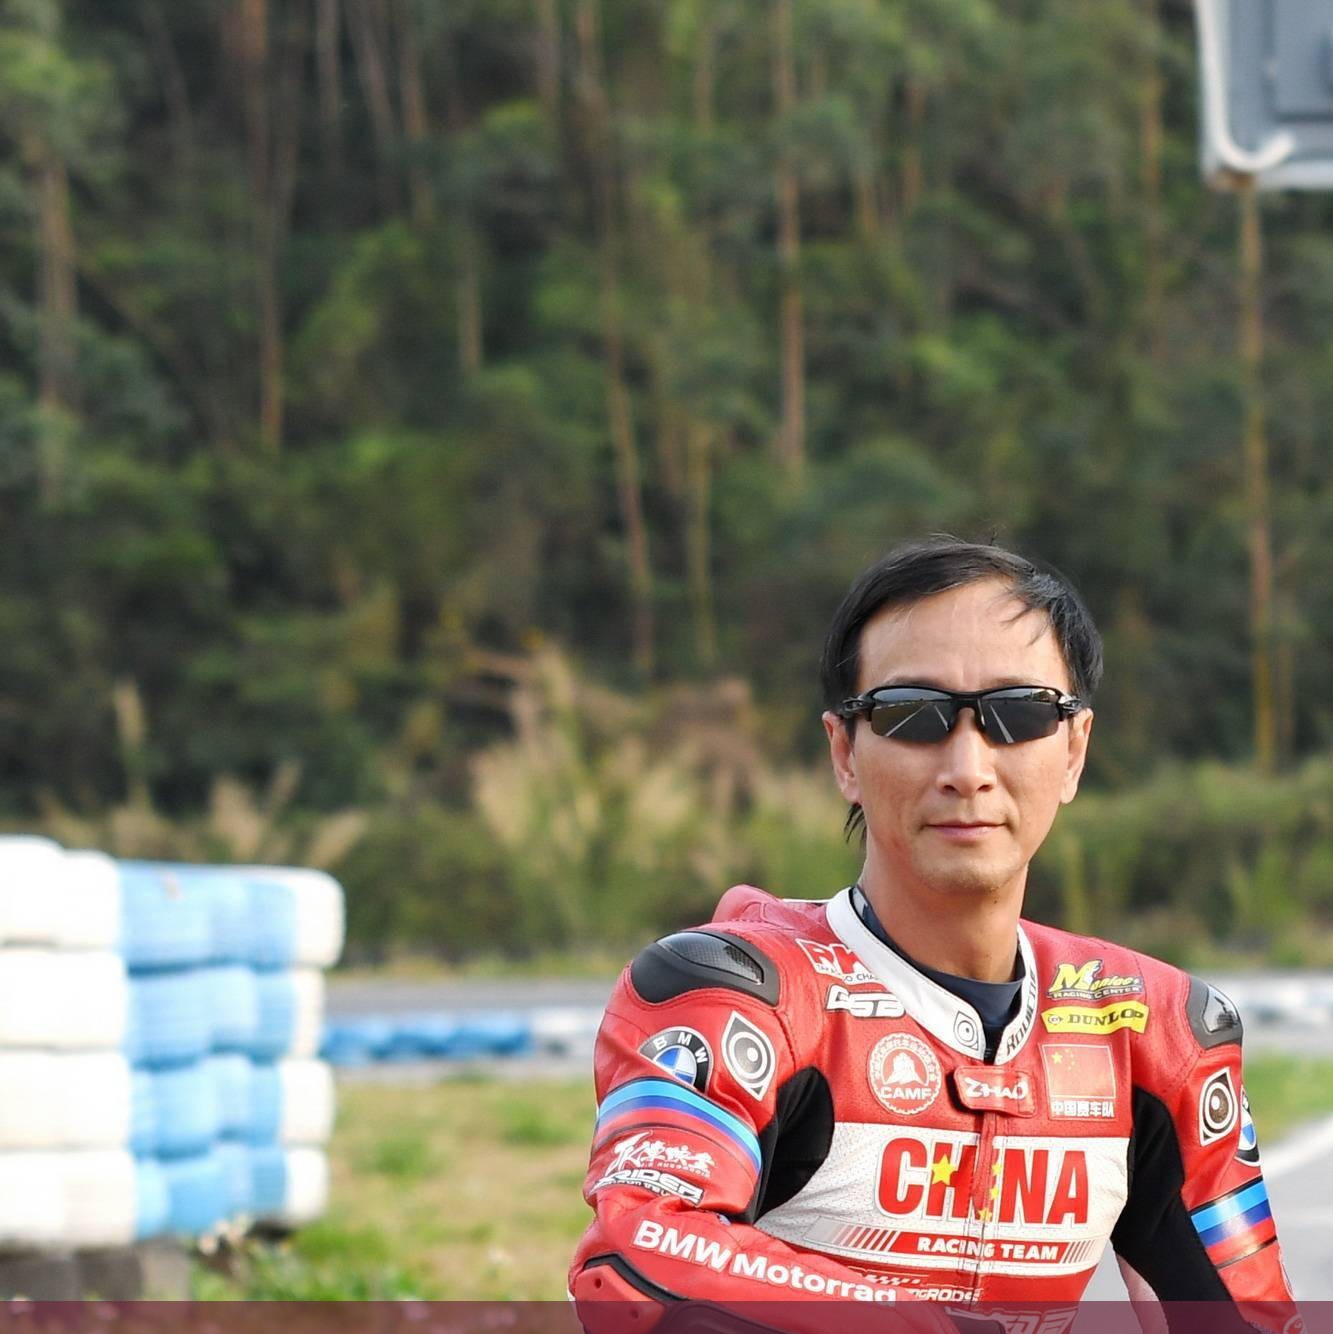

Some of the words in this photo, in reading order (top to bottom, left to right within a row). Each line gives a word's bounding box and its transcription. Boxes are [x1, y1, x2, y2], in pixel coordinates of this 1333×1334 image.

[653, 1031, 708, 1063] BMW
[633, 1220, 731, 1271] BMW
[732, 1252, 897, 1307] Motorrad
[917, 1236, 994, 1257] RACING
[1001, 1241, 1059, 1260] TEAM
